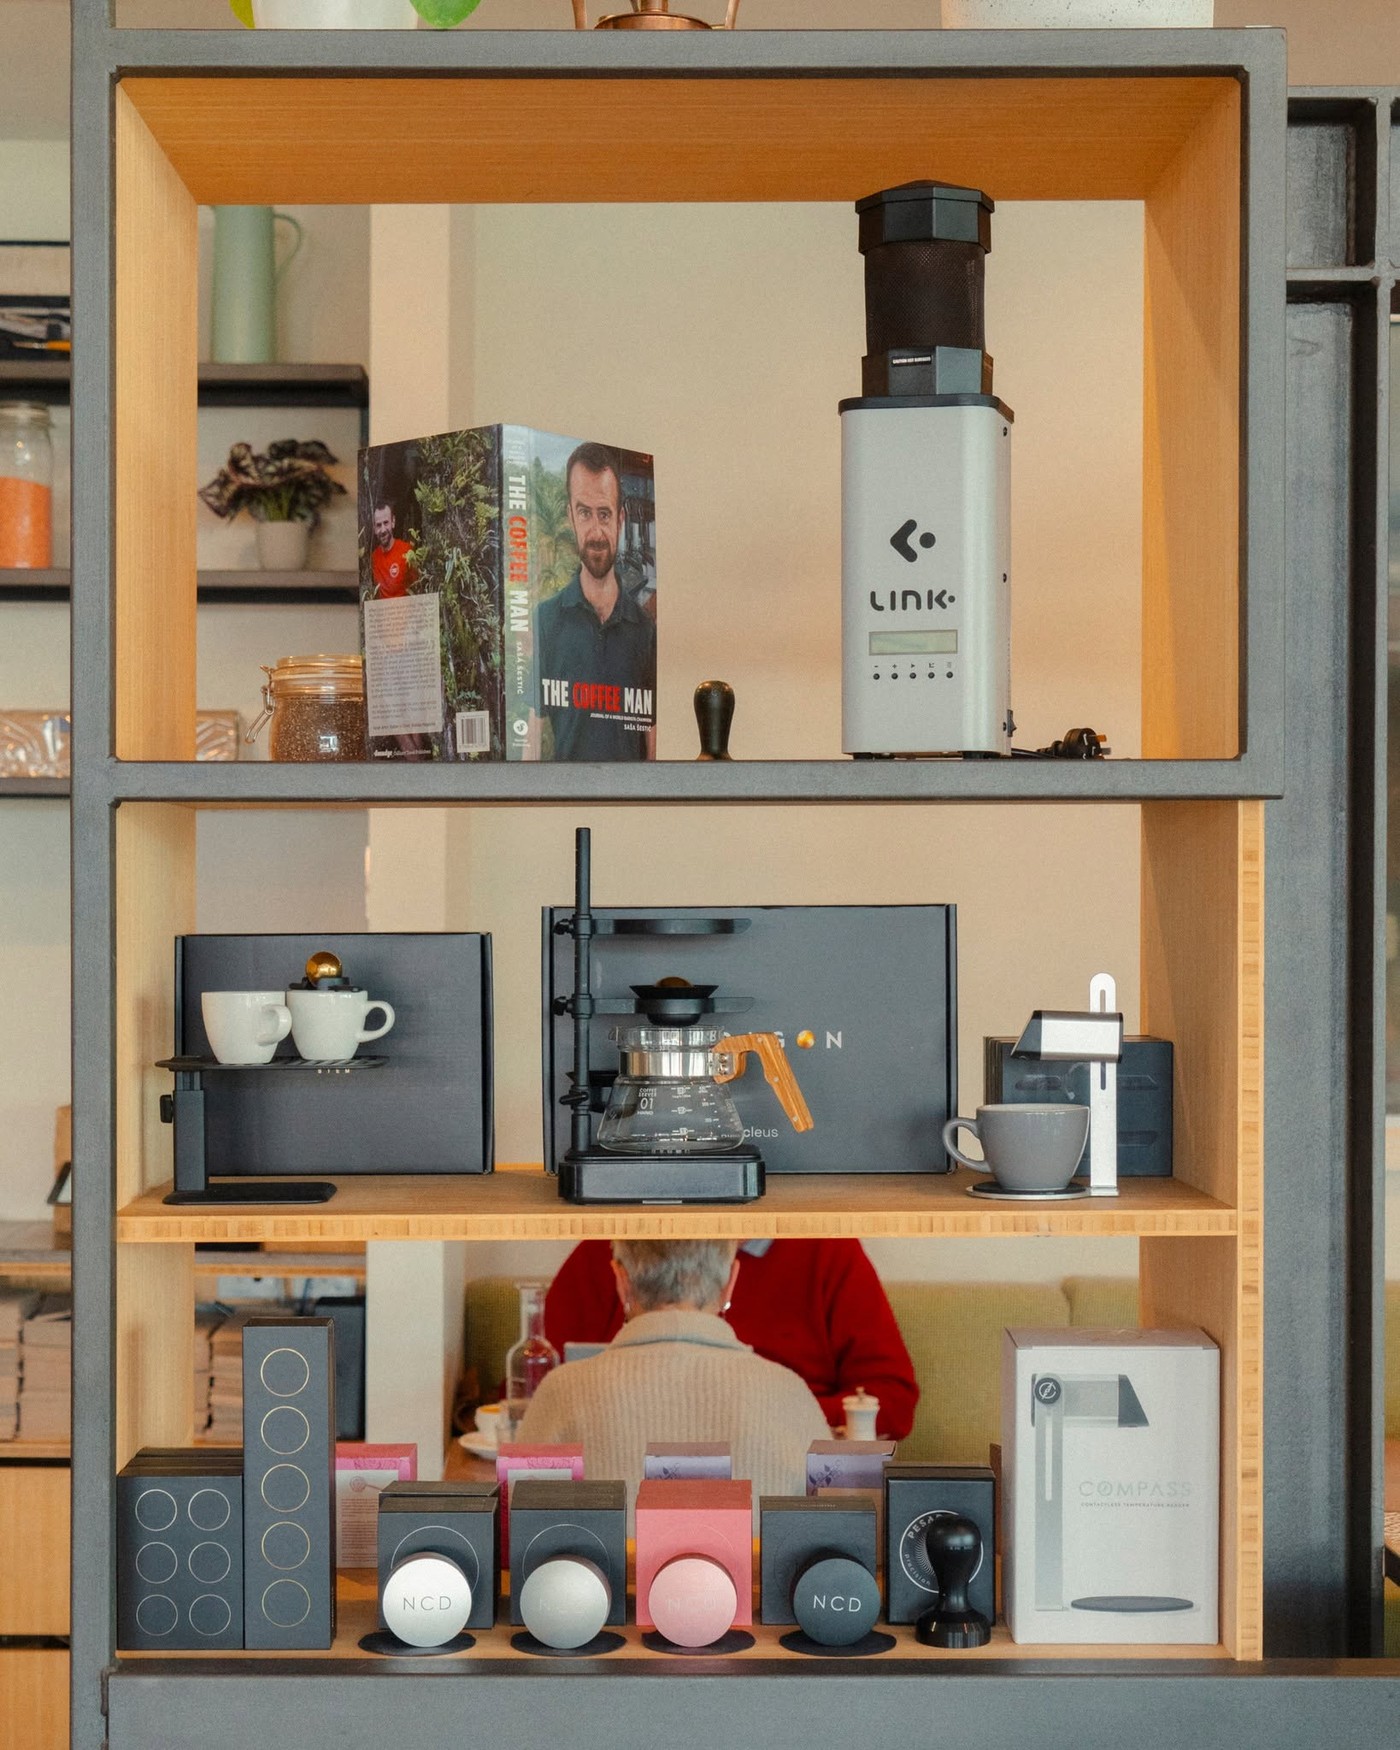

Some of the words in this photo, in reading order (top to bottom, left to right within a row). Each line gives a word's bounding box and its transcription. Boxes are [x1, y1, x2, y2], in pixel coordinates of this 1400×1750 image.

[508, 475, 527, 510] THE
[508, 515, 527, 583] COFFEE
[509, 590, 529, 632] MAN
[870, 589, 955, 611] LINK
[541, 678, 569, 708] THE
[572, 682, 621, 713] COFFEE
[624, 687, 653, 715] MAN
[640, 1097, 654, 1110] 01
[1079, 1480, 1192, 1498] COMPASS
[402, 1595, 453, 1612] NCD
[812, 1594, 862, 1613] NCD
